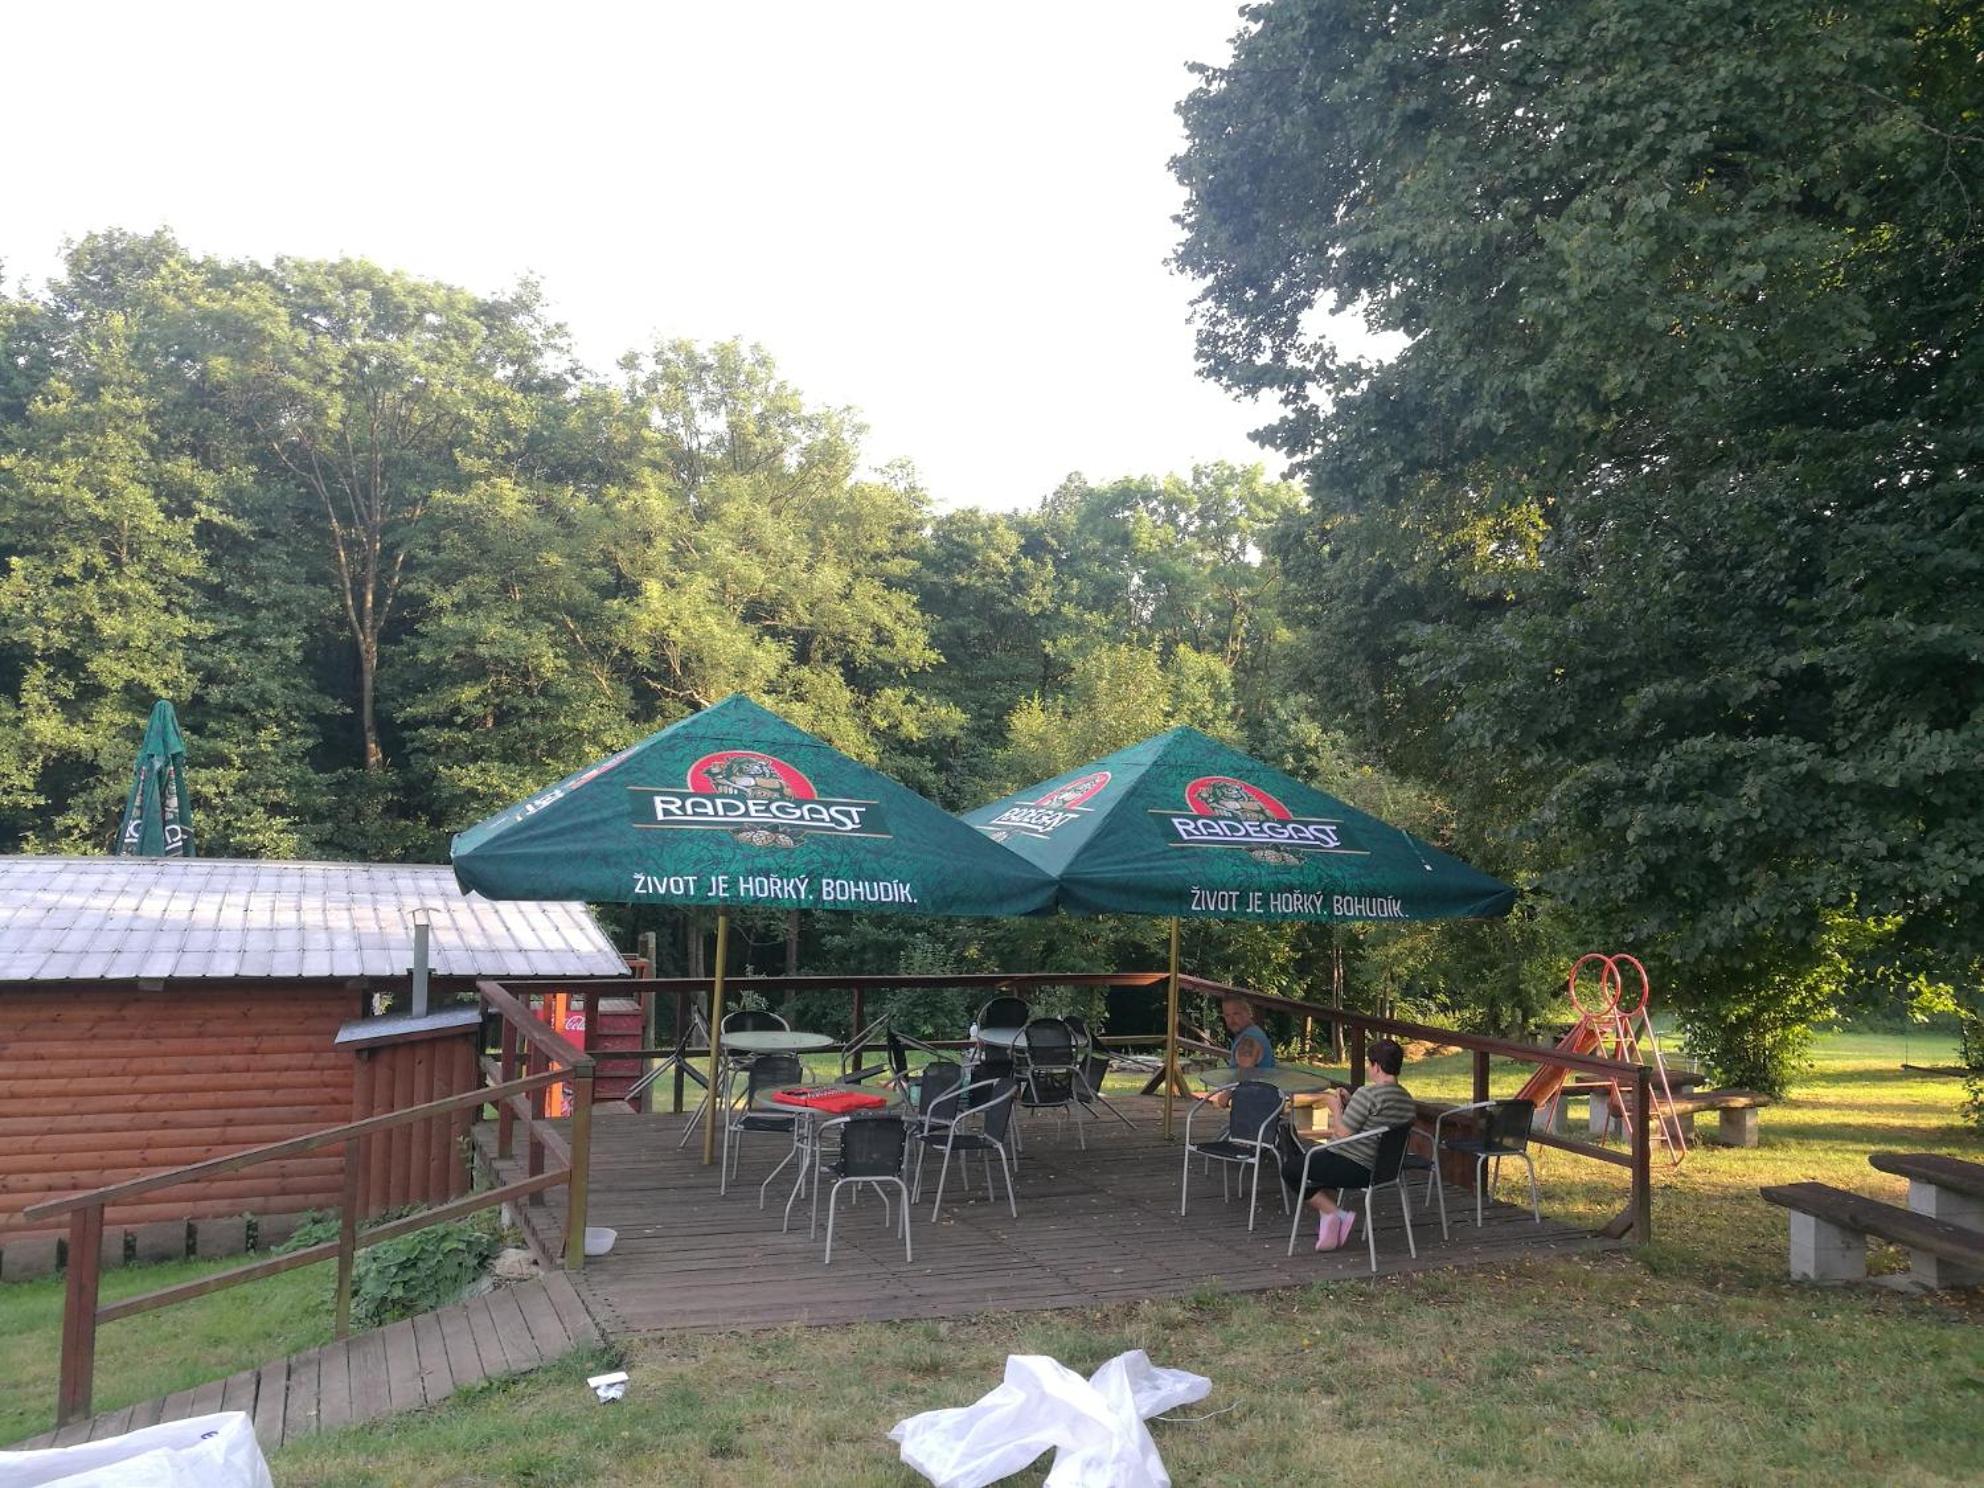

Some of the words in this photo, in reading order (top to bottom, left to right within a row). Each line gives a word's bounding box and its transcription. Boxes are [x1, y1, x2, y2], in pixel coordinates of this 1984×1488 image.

[654, 795, 867, 830] RADEGAST
[1171, 817, 1341, 848] RADEGAST
[632, 872, 698, 896] ŽIVOT
[707, 877, 729, 897] JE
[738, 874, 814, 901] HOŘKÝ.
[822, 879, 918, 904] BOHUDÍK.
[1190, 886, 1240, 912] ŽIVOT
[1246, 892, 1263, 913] JE
[1270, 889, 1328, 916] HOŘKÝ.
[1333, 894, 1410, 919] BOHUDÍK.
